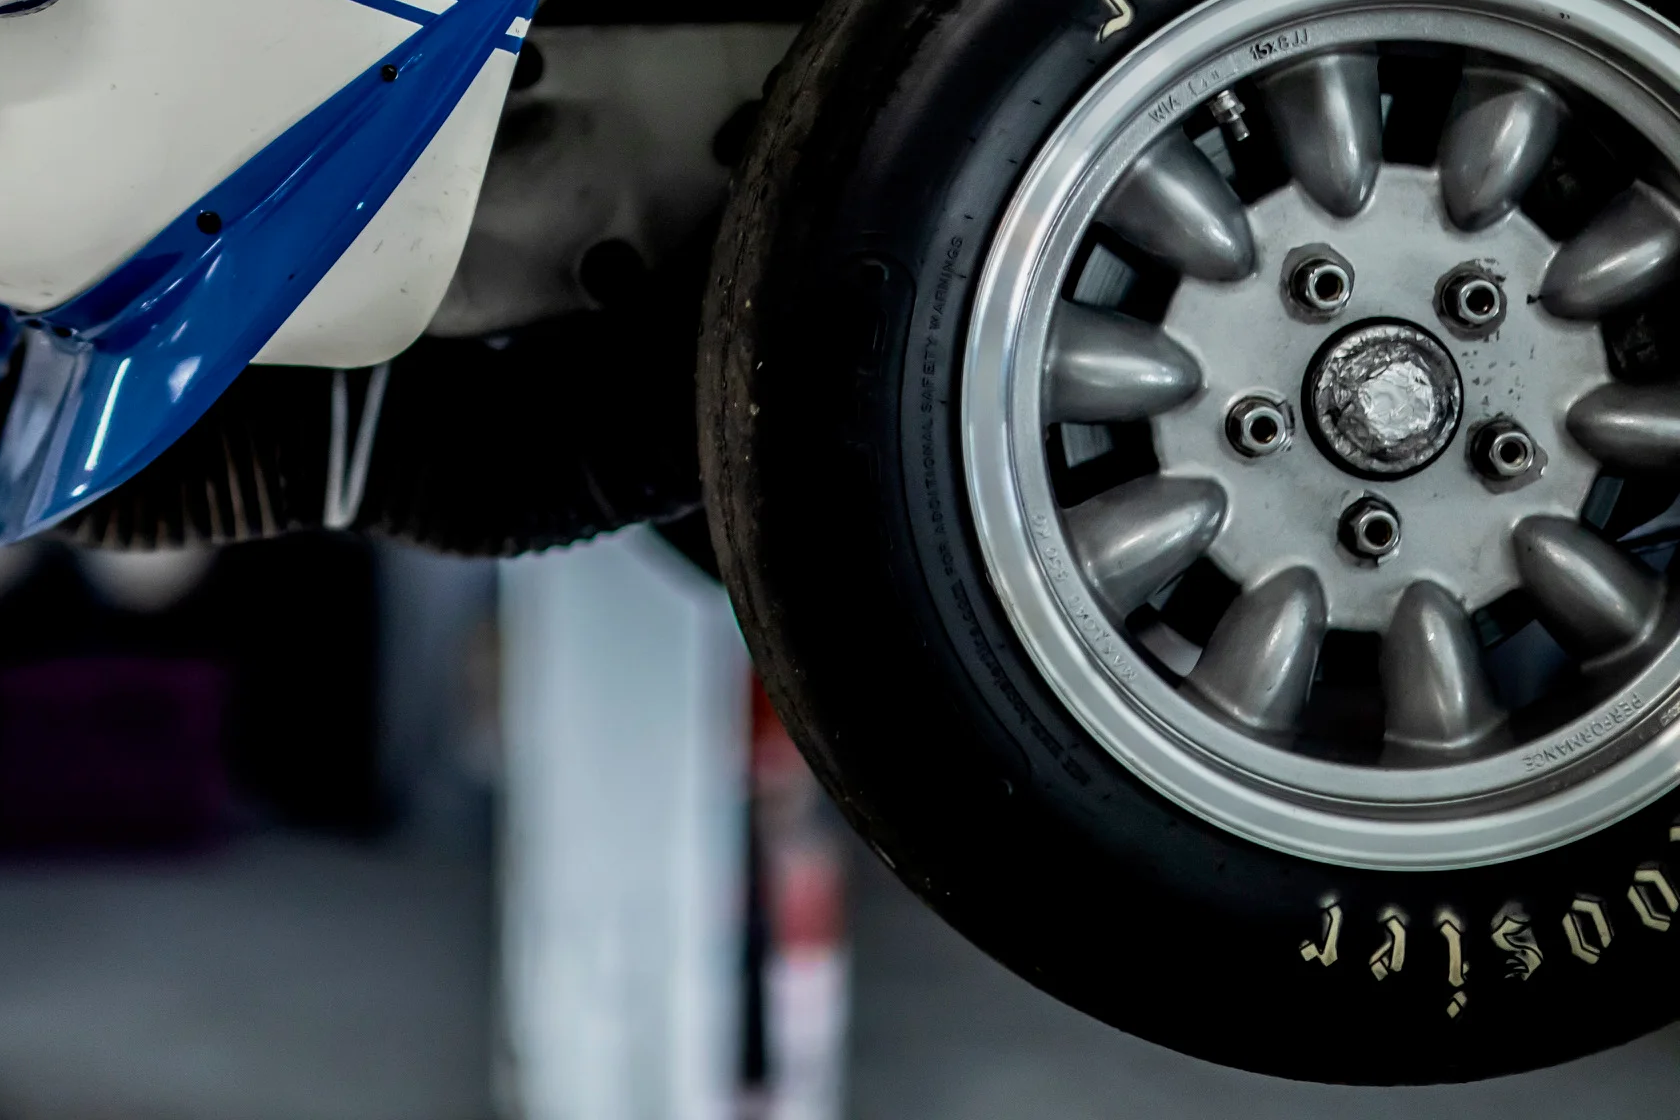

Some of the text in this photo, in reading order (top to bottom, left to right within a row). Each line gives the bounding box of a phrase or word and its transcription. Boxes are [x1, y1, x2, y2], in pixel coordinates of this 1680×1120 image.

[929, 236, 963, 330] WARNINGS
[920, 337, 938, 412] SAFETY
[921, 417, 947, 535] ADDITIONAL
[1521, 692, 1644, 772] PERFORMANCE
[1300, 827, 1680, 1018] oosier
